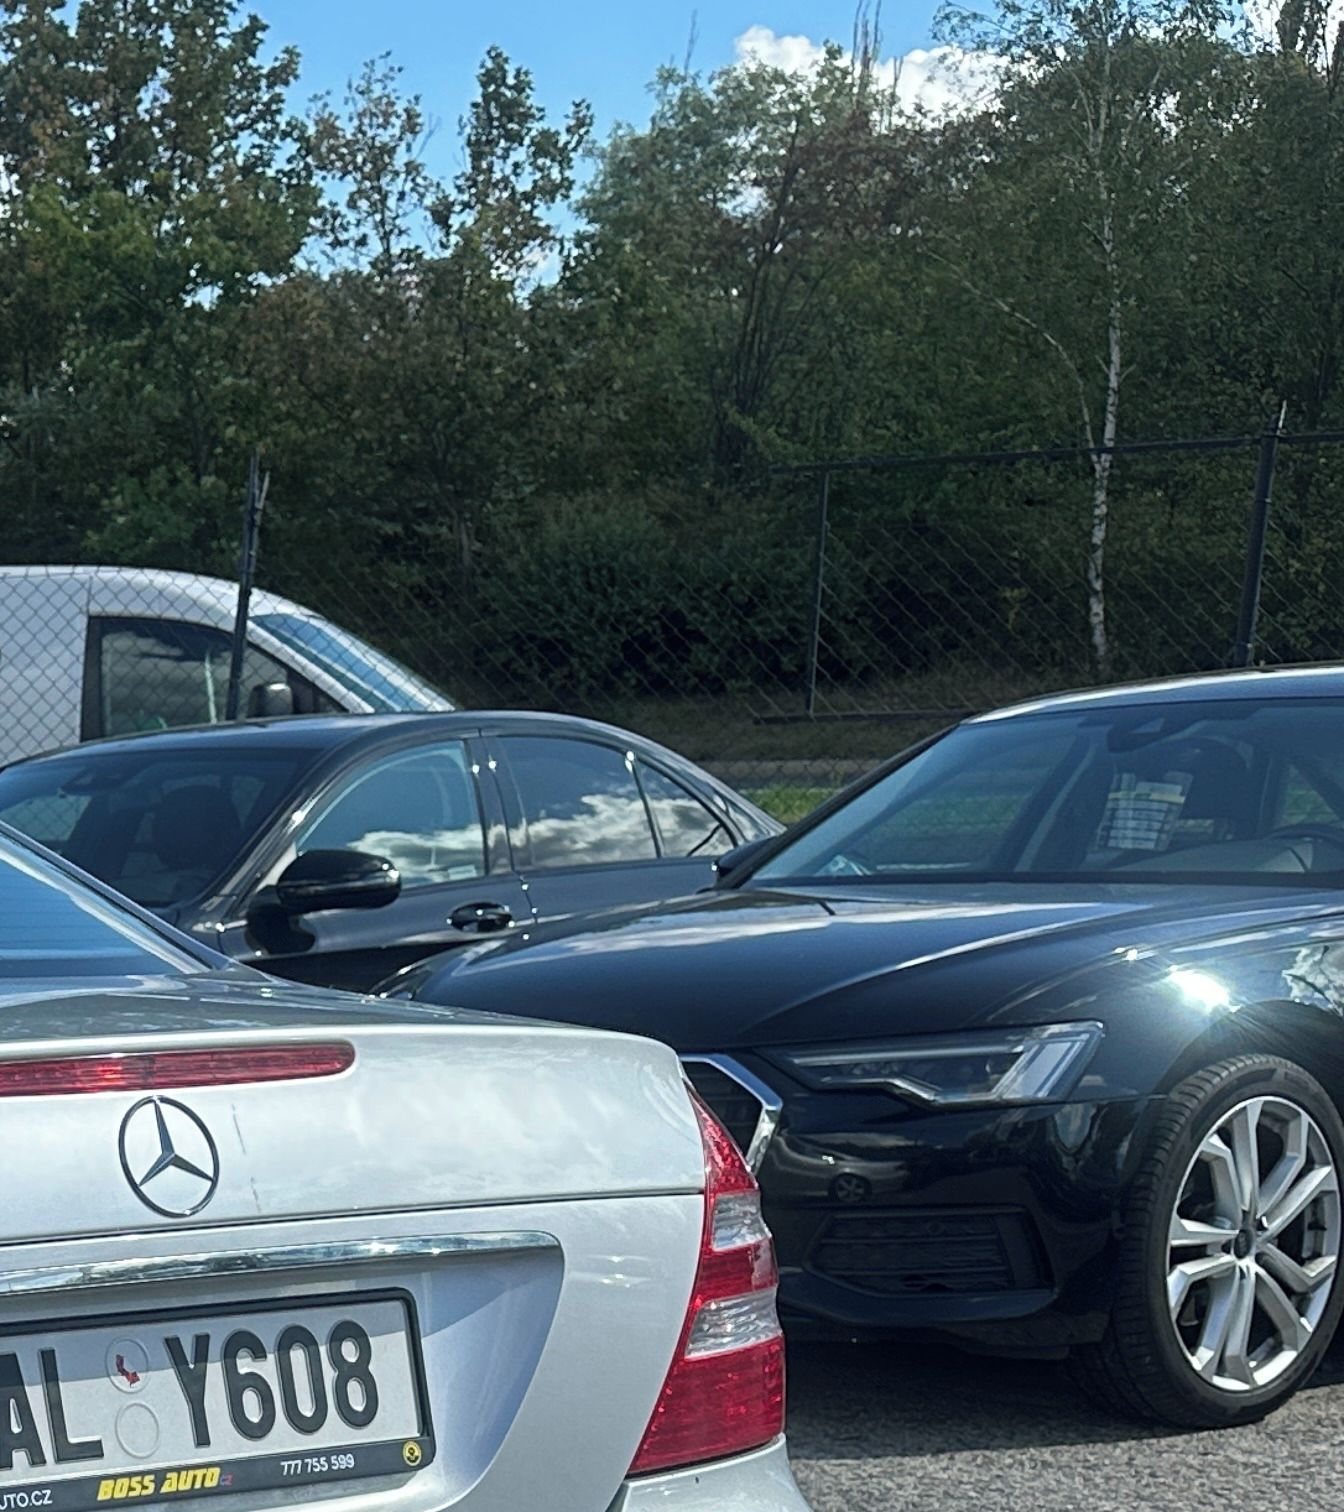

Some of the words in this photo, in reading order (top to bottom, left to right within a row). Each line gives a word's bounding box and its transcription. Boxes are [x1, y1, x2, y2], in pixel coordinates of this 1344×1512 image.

[163, 1319, 379, 1448] Y608
[280, 1459, 302, 1476] 777
[304, 1456, 328, 1472] 755
[330, 1453, 355, 1470] 599
[97, 1474, 155, 1501] BOSS
[160, 1467, 220, 1493] AUTO
